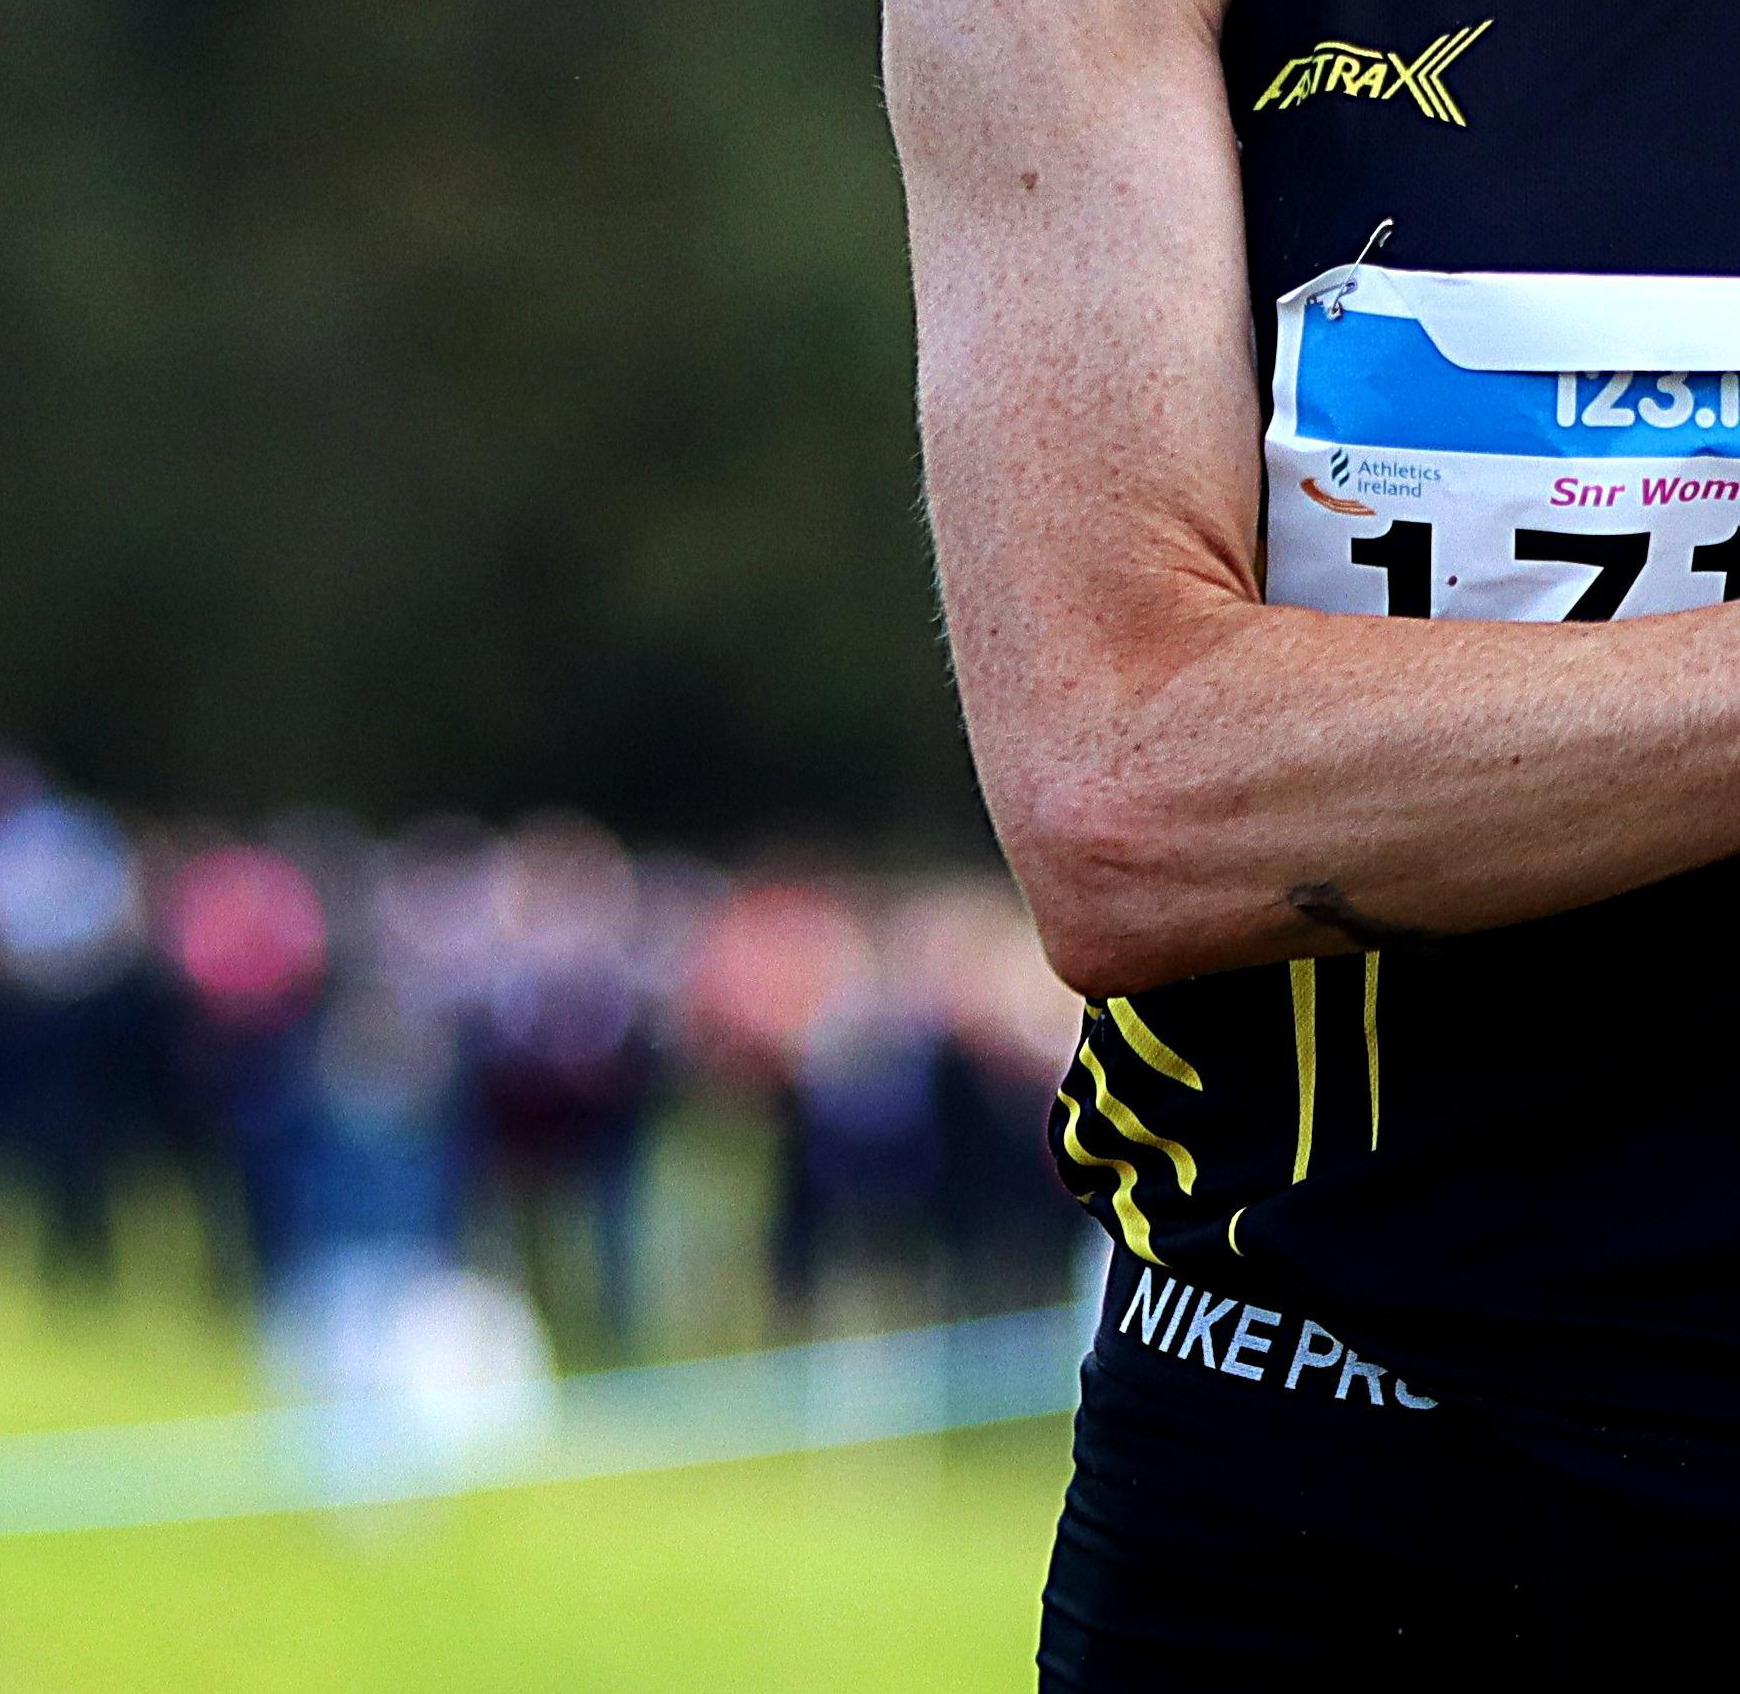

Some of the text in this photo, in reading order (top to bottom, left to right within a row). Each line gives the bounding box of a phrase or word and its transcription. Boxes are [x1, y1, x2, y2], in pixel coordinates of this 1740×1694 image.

[1357, 460, 1442, 481] Athletics
[1358, 479, 1422, 498] Ireland
[1549, 477, 1625, 507] Snr
[1119, 1266, 1282, 1381] NIKE
